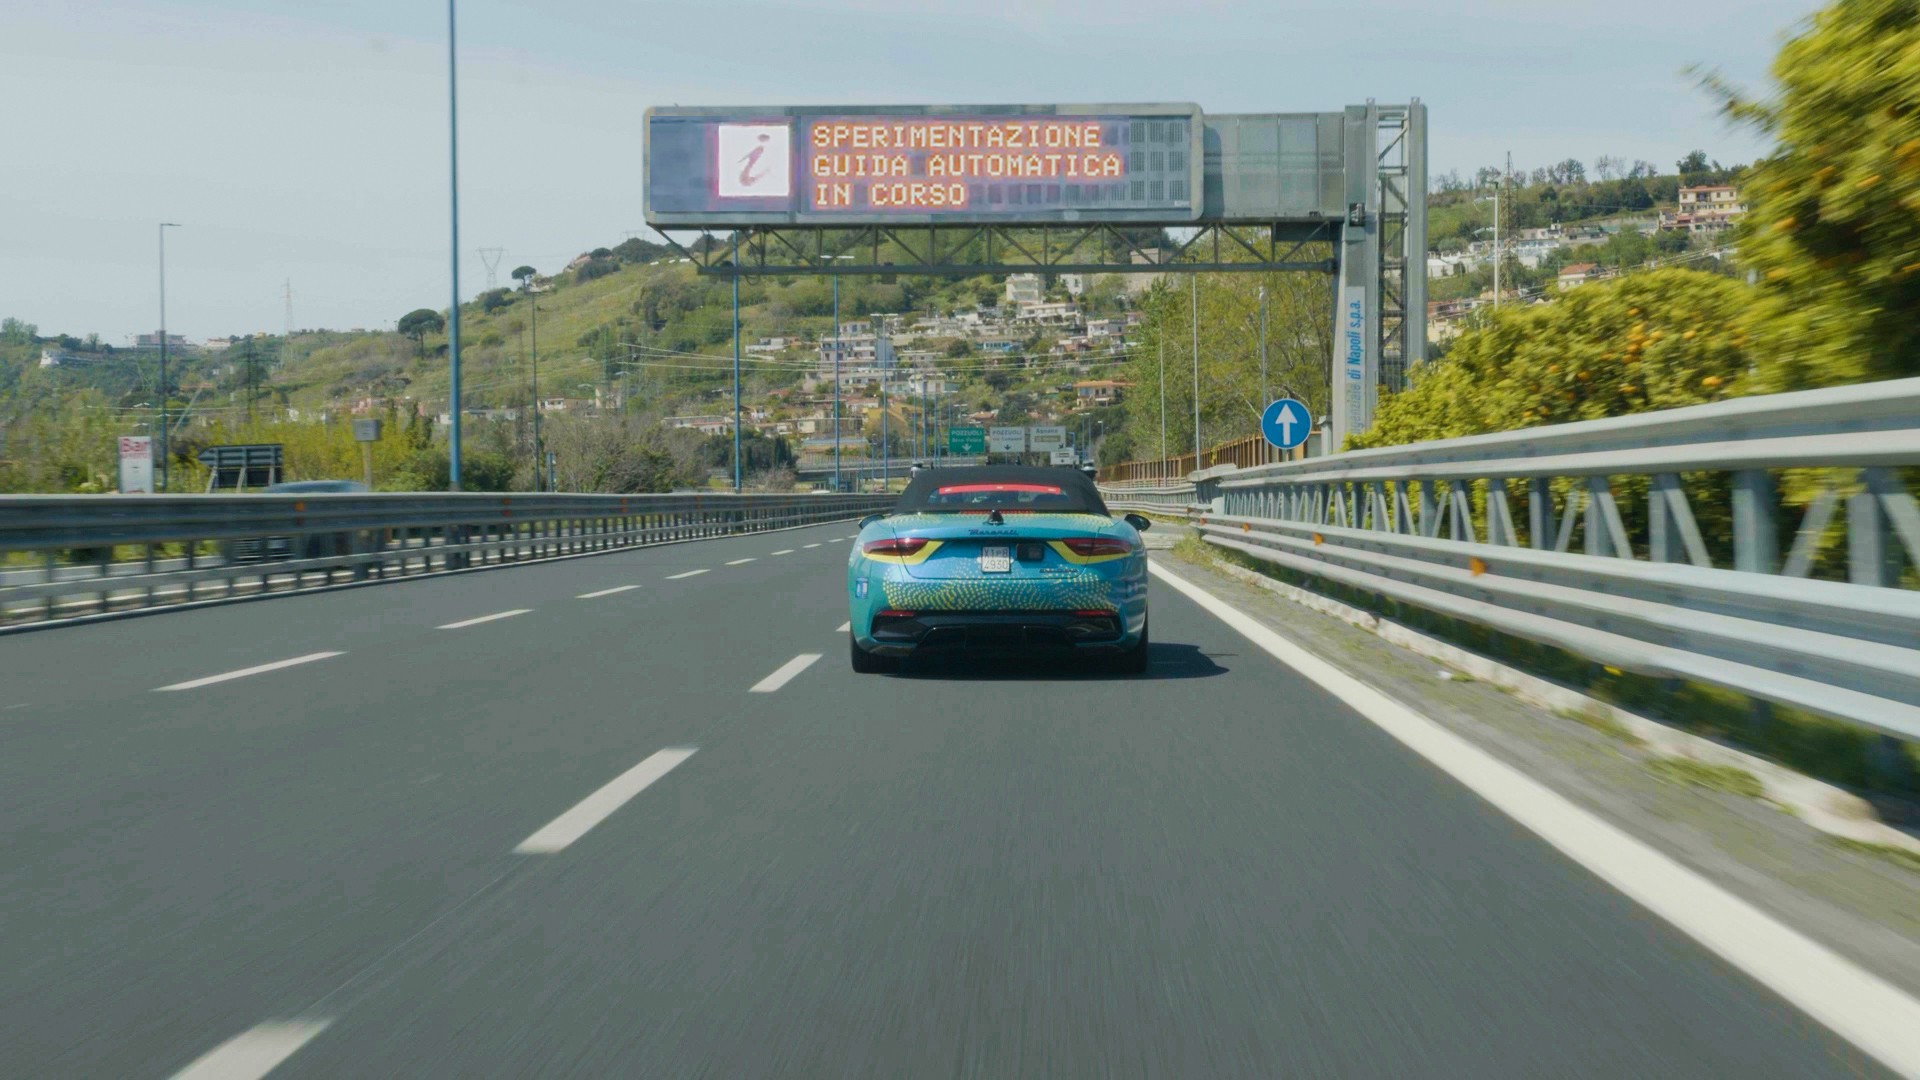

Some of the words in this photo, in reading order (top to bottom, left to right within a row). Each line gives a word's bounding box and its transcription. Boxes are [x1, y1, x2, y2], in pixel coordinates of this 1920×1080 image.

[813, 125, 1101, 148] SPERIMENTAZIONE
[813, 154, 909, 177] GUIDA
[928, 154, 1121, 177] AUTOMATICA
[815, 183, 850, 206] IN
[870, 183, 965, 206] CORSO
[1348, 300, 1364, 329] s.p.a.
[1346, 330, 1363, 366] Napoli
[1346, 369, 1361, 380] di
[120, 438, 151, 452] Bar
